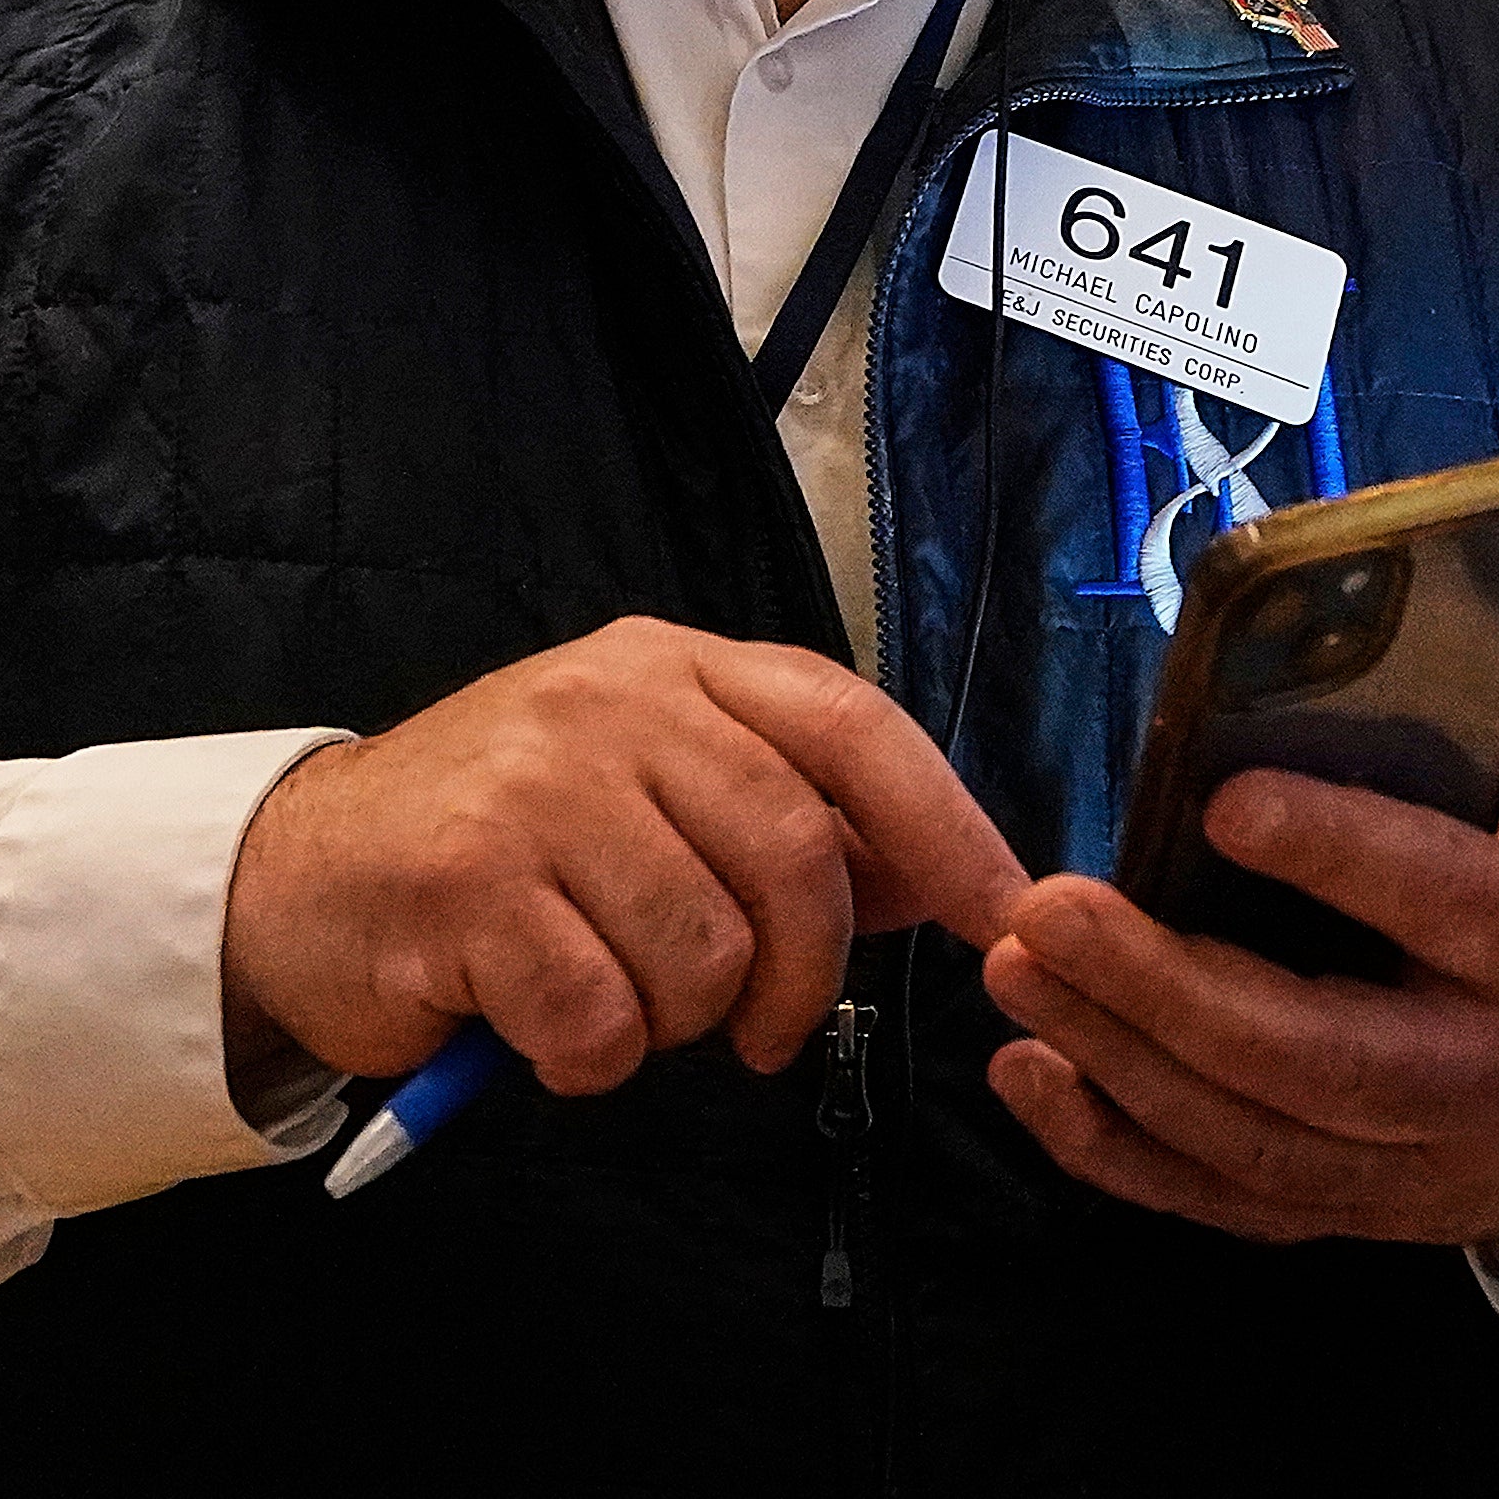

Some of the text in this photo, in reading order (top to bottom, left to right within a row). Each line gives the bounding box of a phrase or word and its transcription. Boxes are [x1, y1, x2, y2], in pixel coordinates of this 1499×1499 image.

[1010, 247, 1258, 355] MICHAEL CAPOLINO
[1059, 186, 1246, 310] 641
[1052, 309, 1172, 366] SECURITIES
[1185, 358, 1246, 395] CORP.
